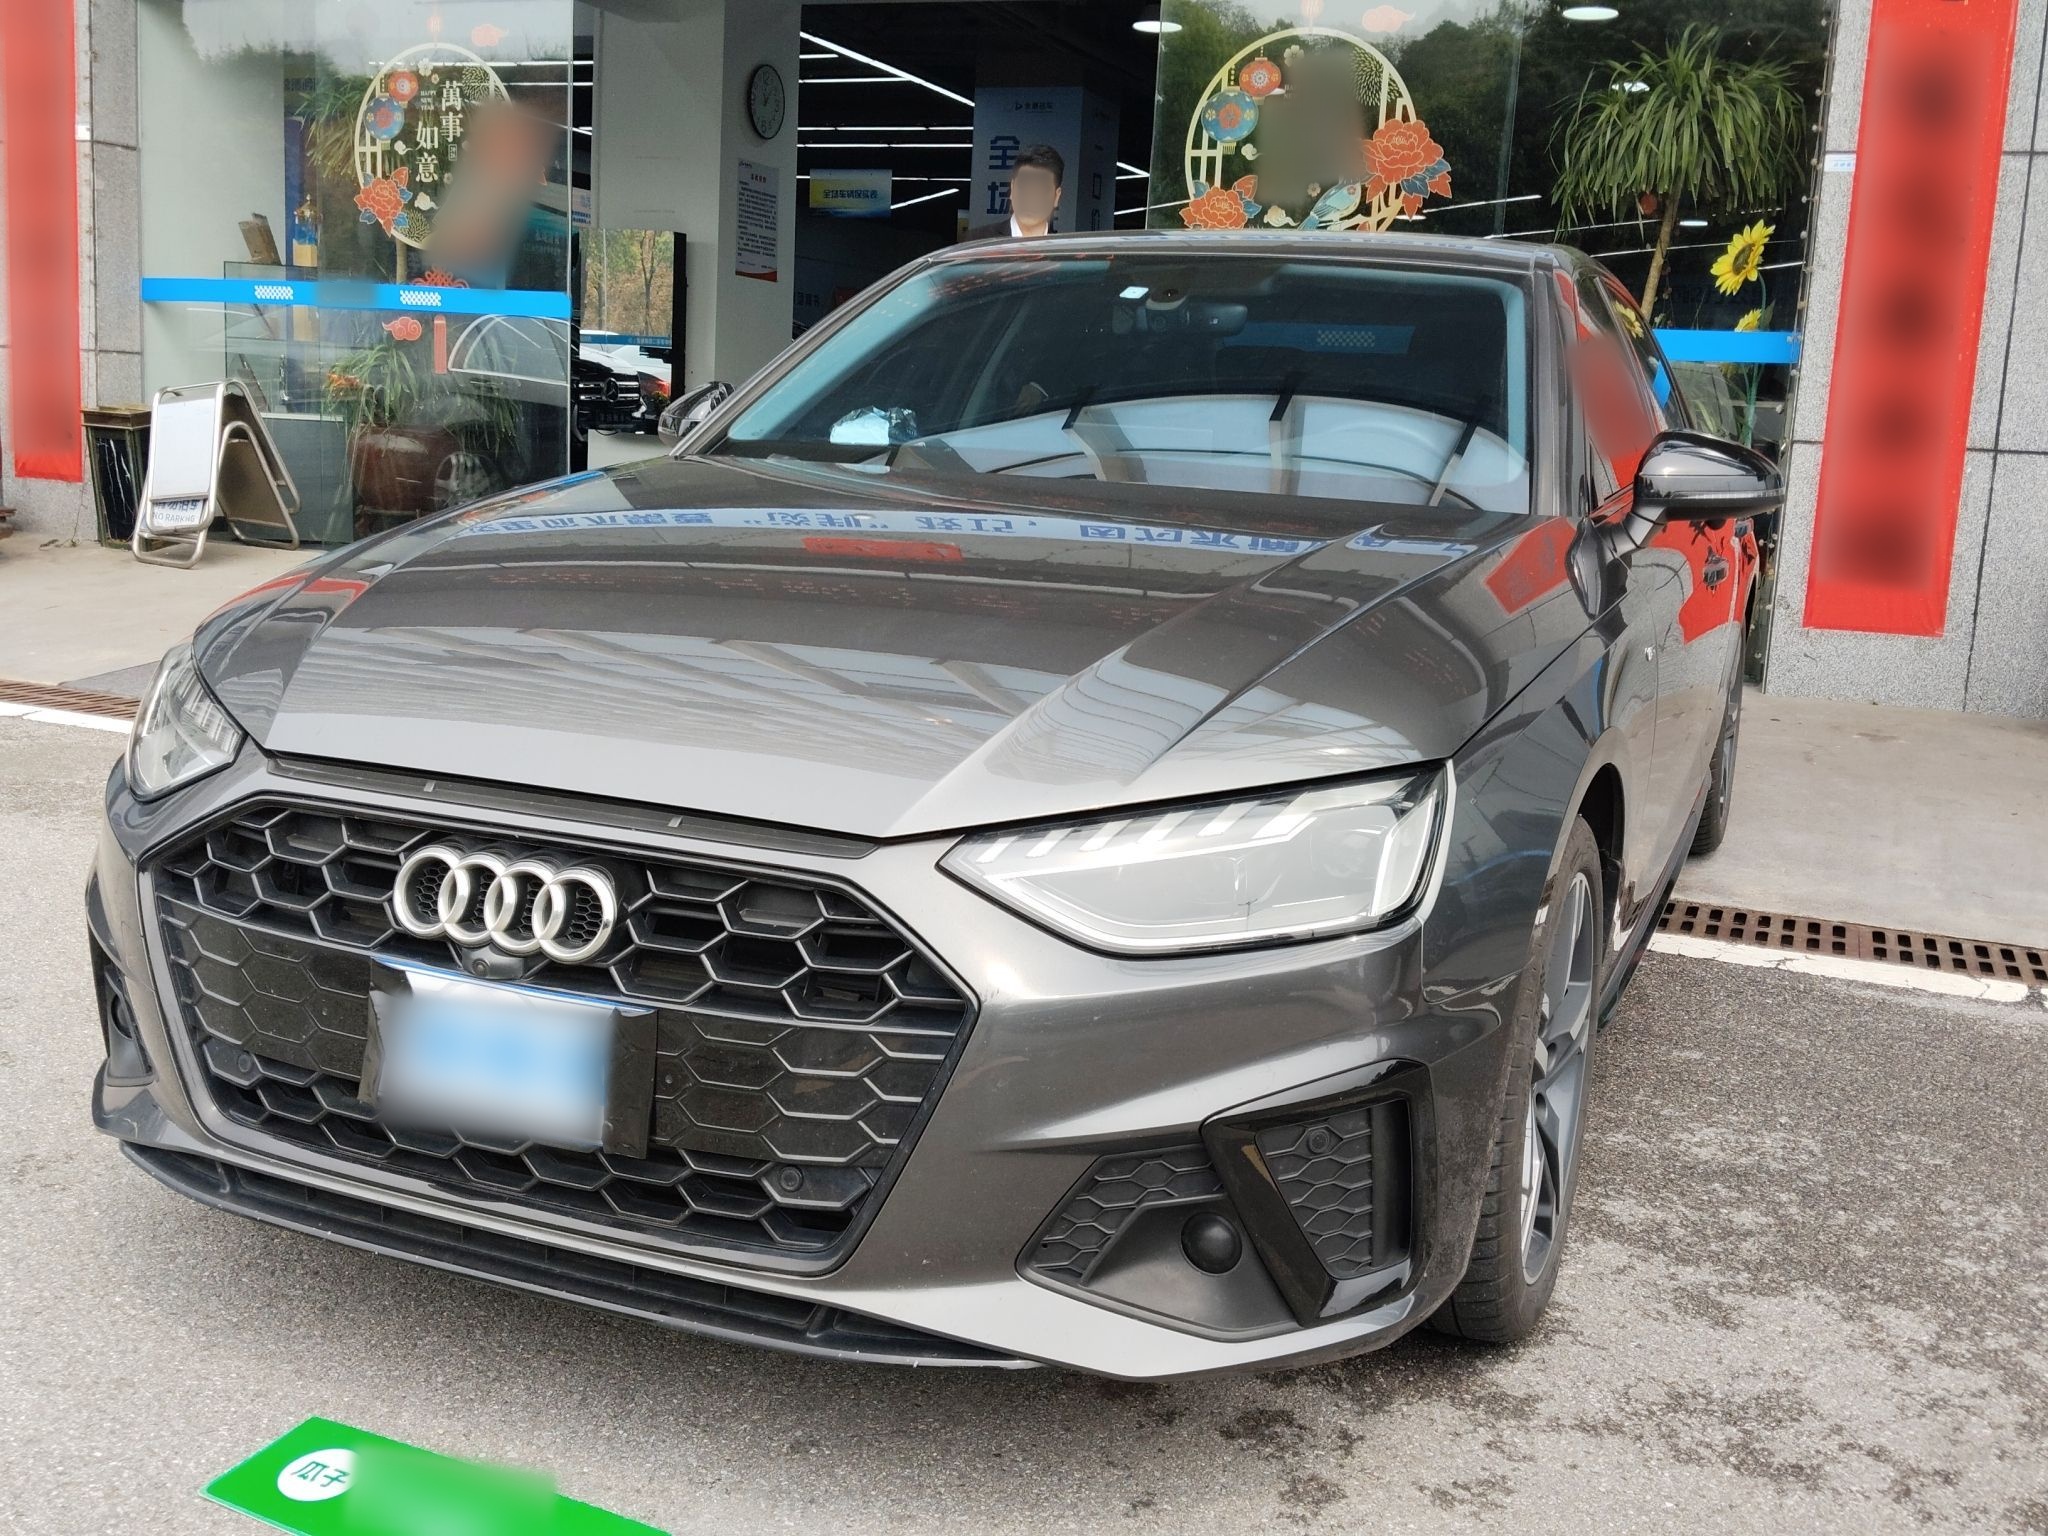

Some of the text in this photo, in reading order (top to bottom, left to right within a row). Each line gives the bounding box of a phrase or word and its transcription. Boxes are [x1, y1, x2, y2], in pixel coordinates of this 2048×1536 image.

[440, 80, 464, 143] 萬事
[415, 120, 439, 183] 如意
[290, 1461, 351, 1487] 瓜子
